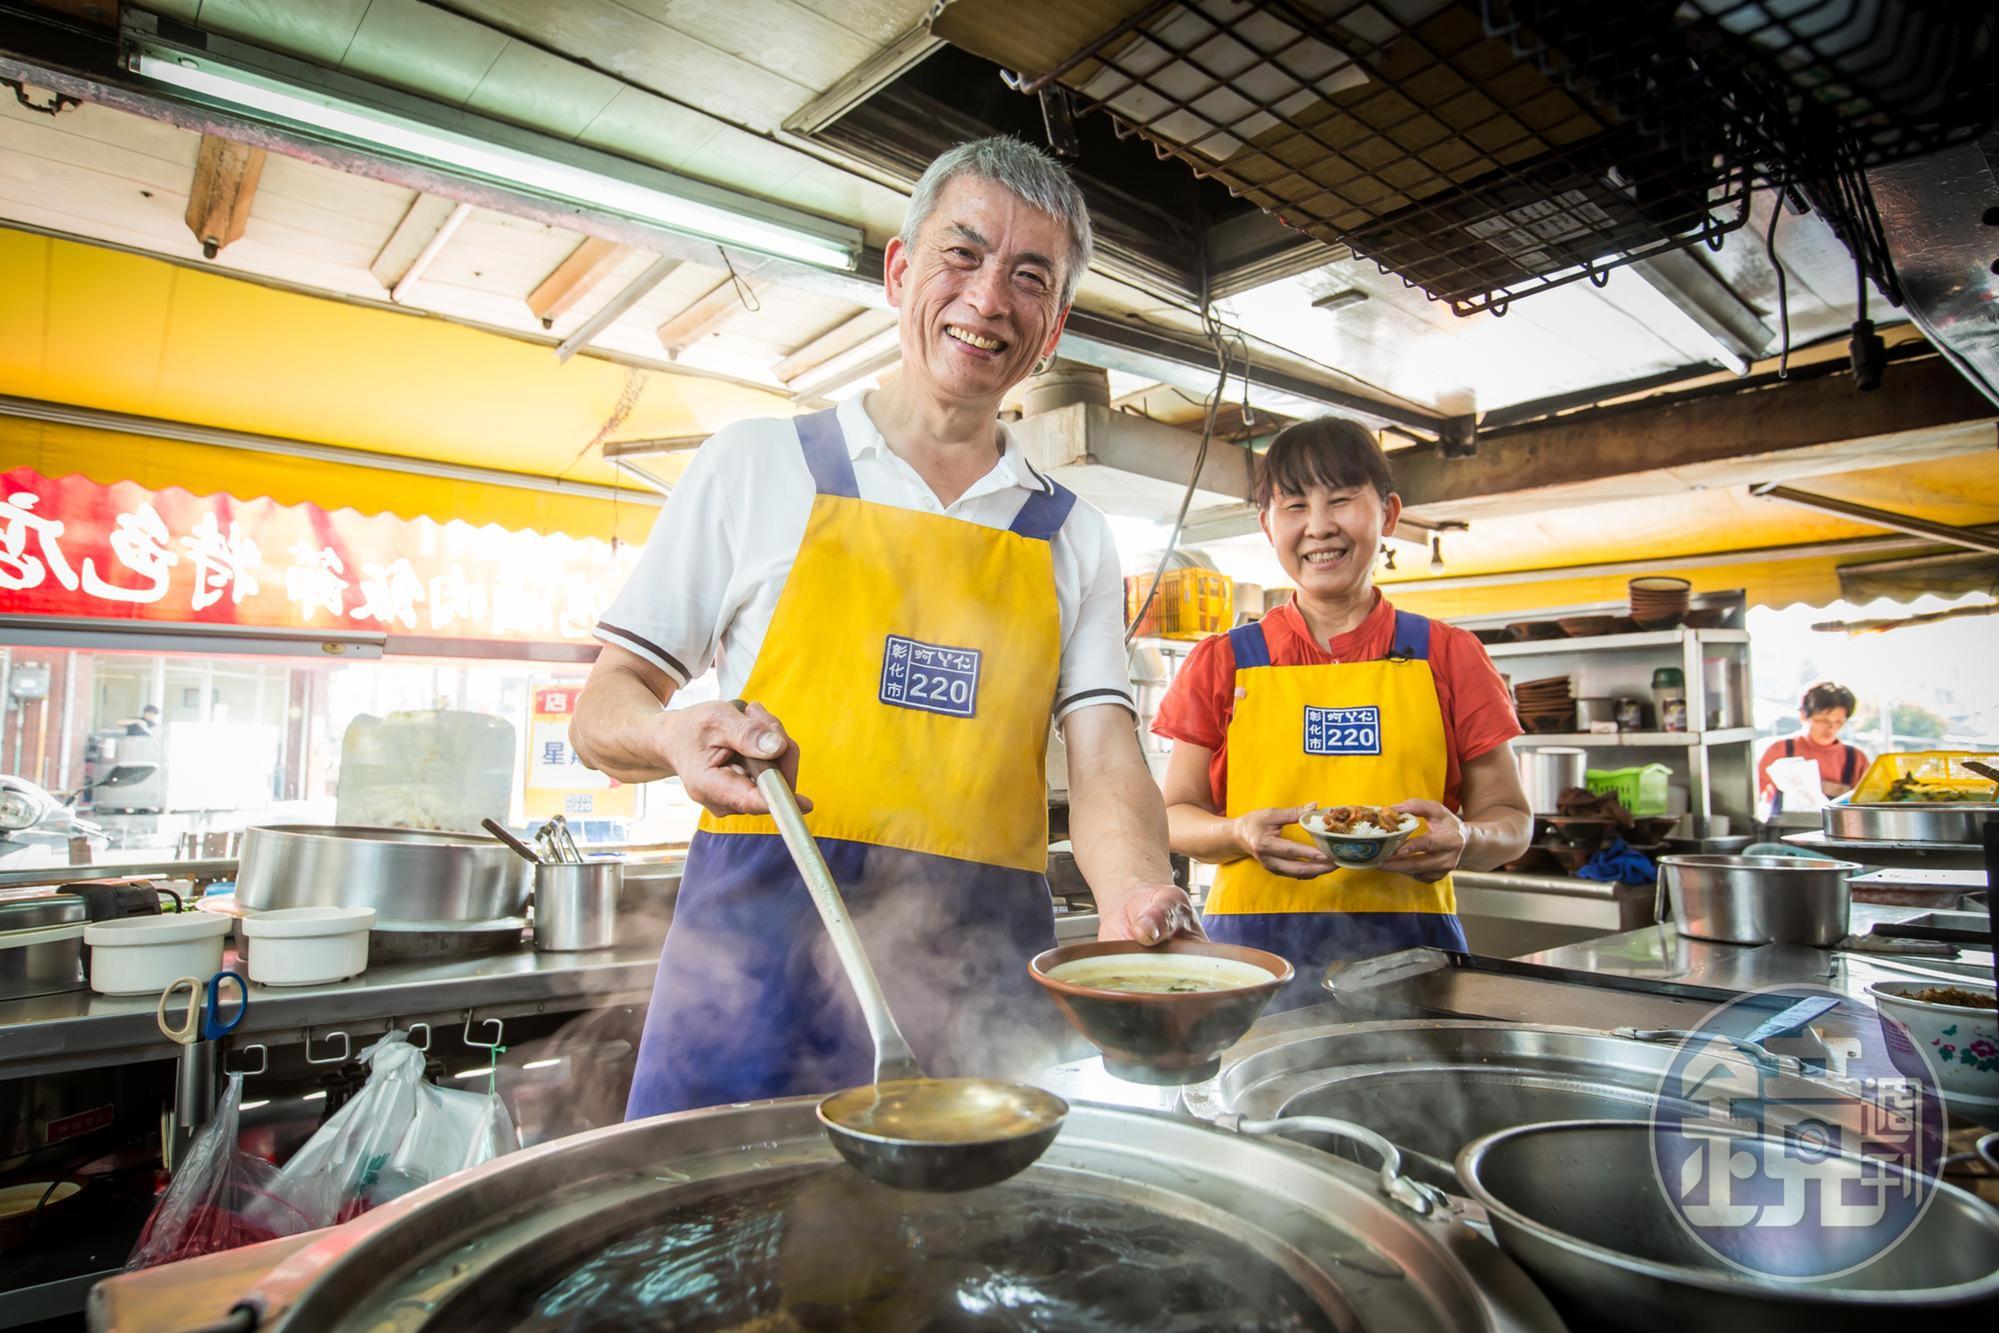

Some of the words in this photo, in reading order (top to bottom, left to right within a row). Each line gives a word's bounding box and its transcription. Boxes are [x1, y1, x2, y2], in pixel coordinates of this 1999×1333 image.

[887, 643, 908, 697] 彰化市
[909, 673, 968, 704] 220
[1309, 711, 1322, 749] 彰化市
[1327, 728, 1375, 746] 220
